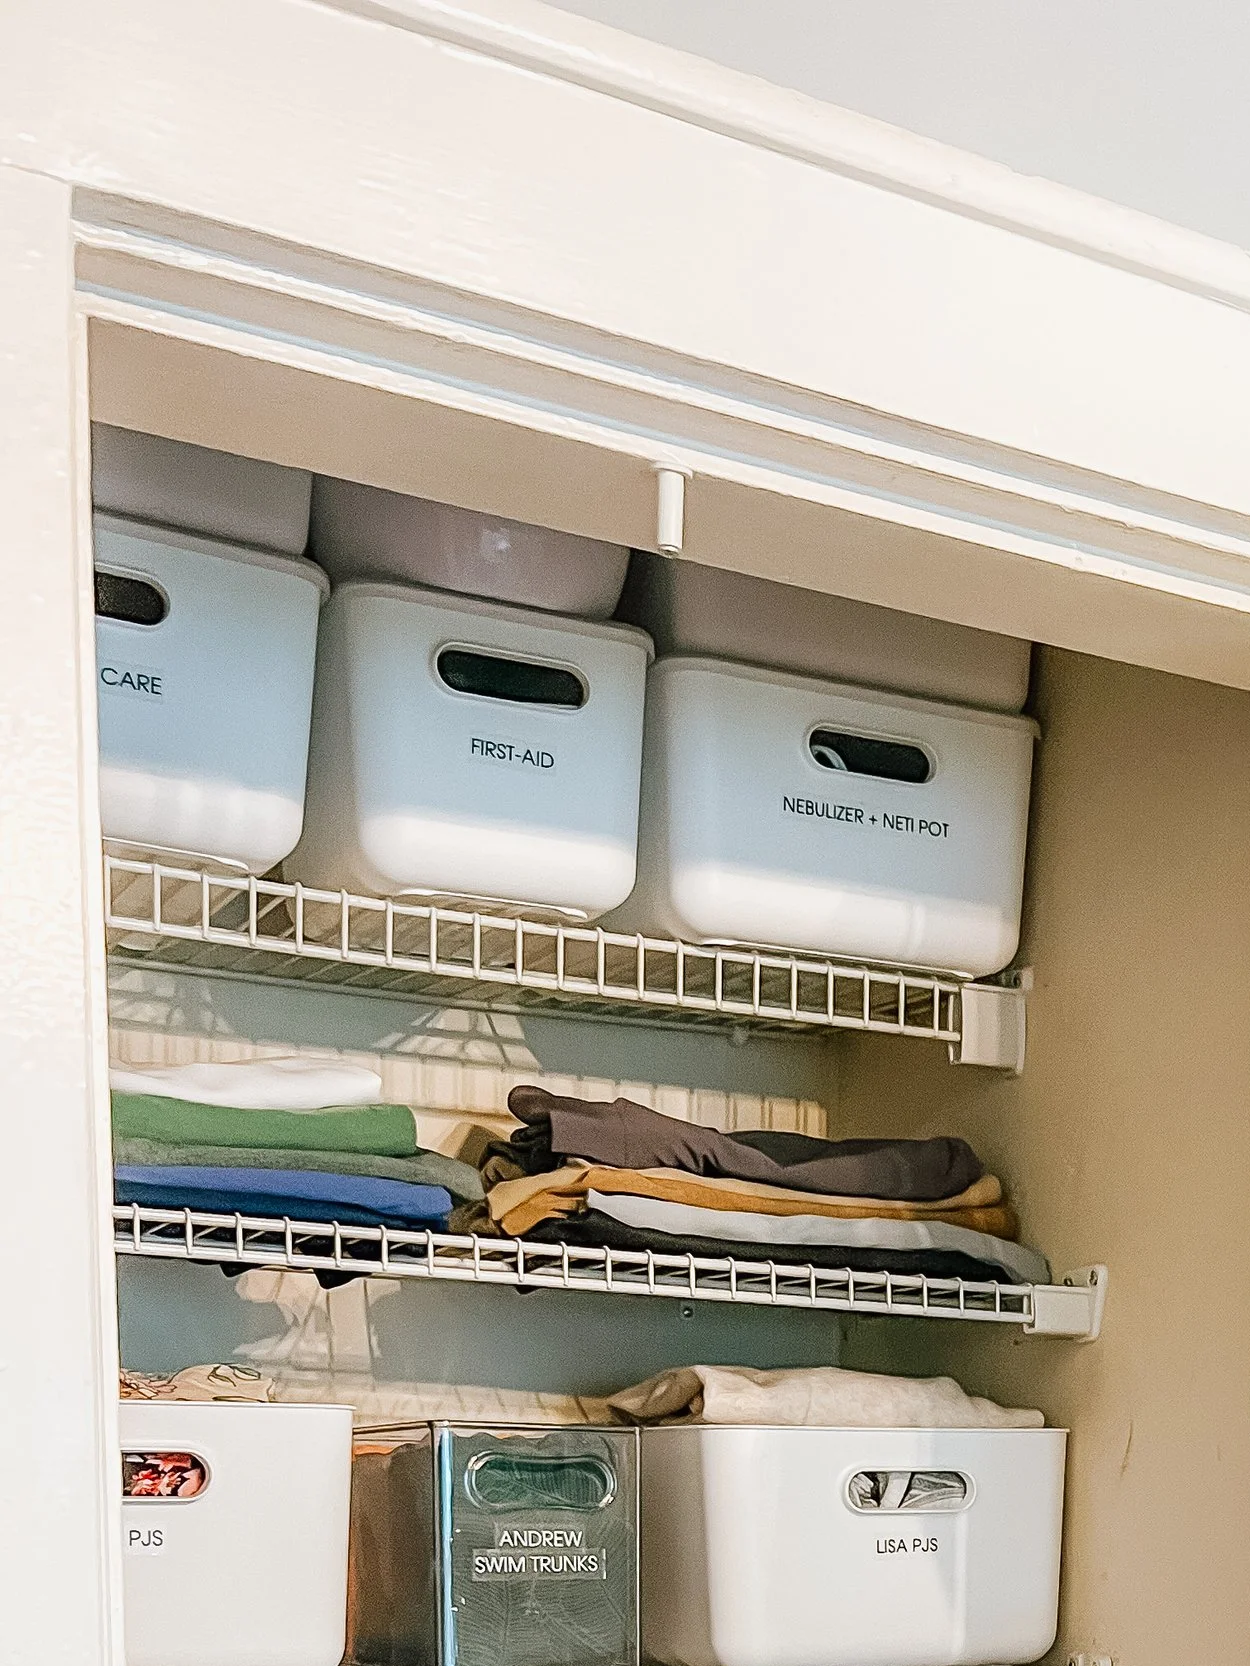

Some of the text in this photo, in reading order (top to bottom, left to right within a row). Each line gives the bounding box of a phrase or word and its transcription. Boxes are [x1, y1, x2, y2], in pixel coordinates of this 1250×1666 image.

[101, 667, 162, 695] CARE
[471, 738, 554, 768] FIRST-AID
[783, 796, 949, 837] NEBULIZER + NETI POT
[129, 1530, 163, 1546] PJS
[499, 1530, 583, 1547] ANDREW
[877, 1537, 938, 1553] LISA PJS
[475, 1555, 598, 1574] SWIM TRUNKS
